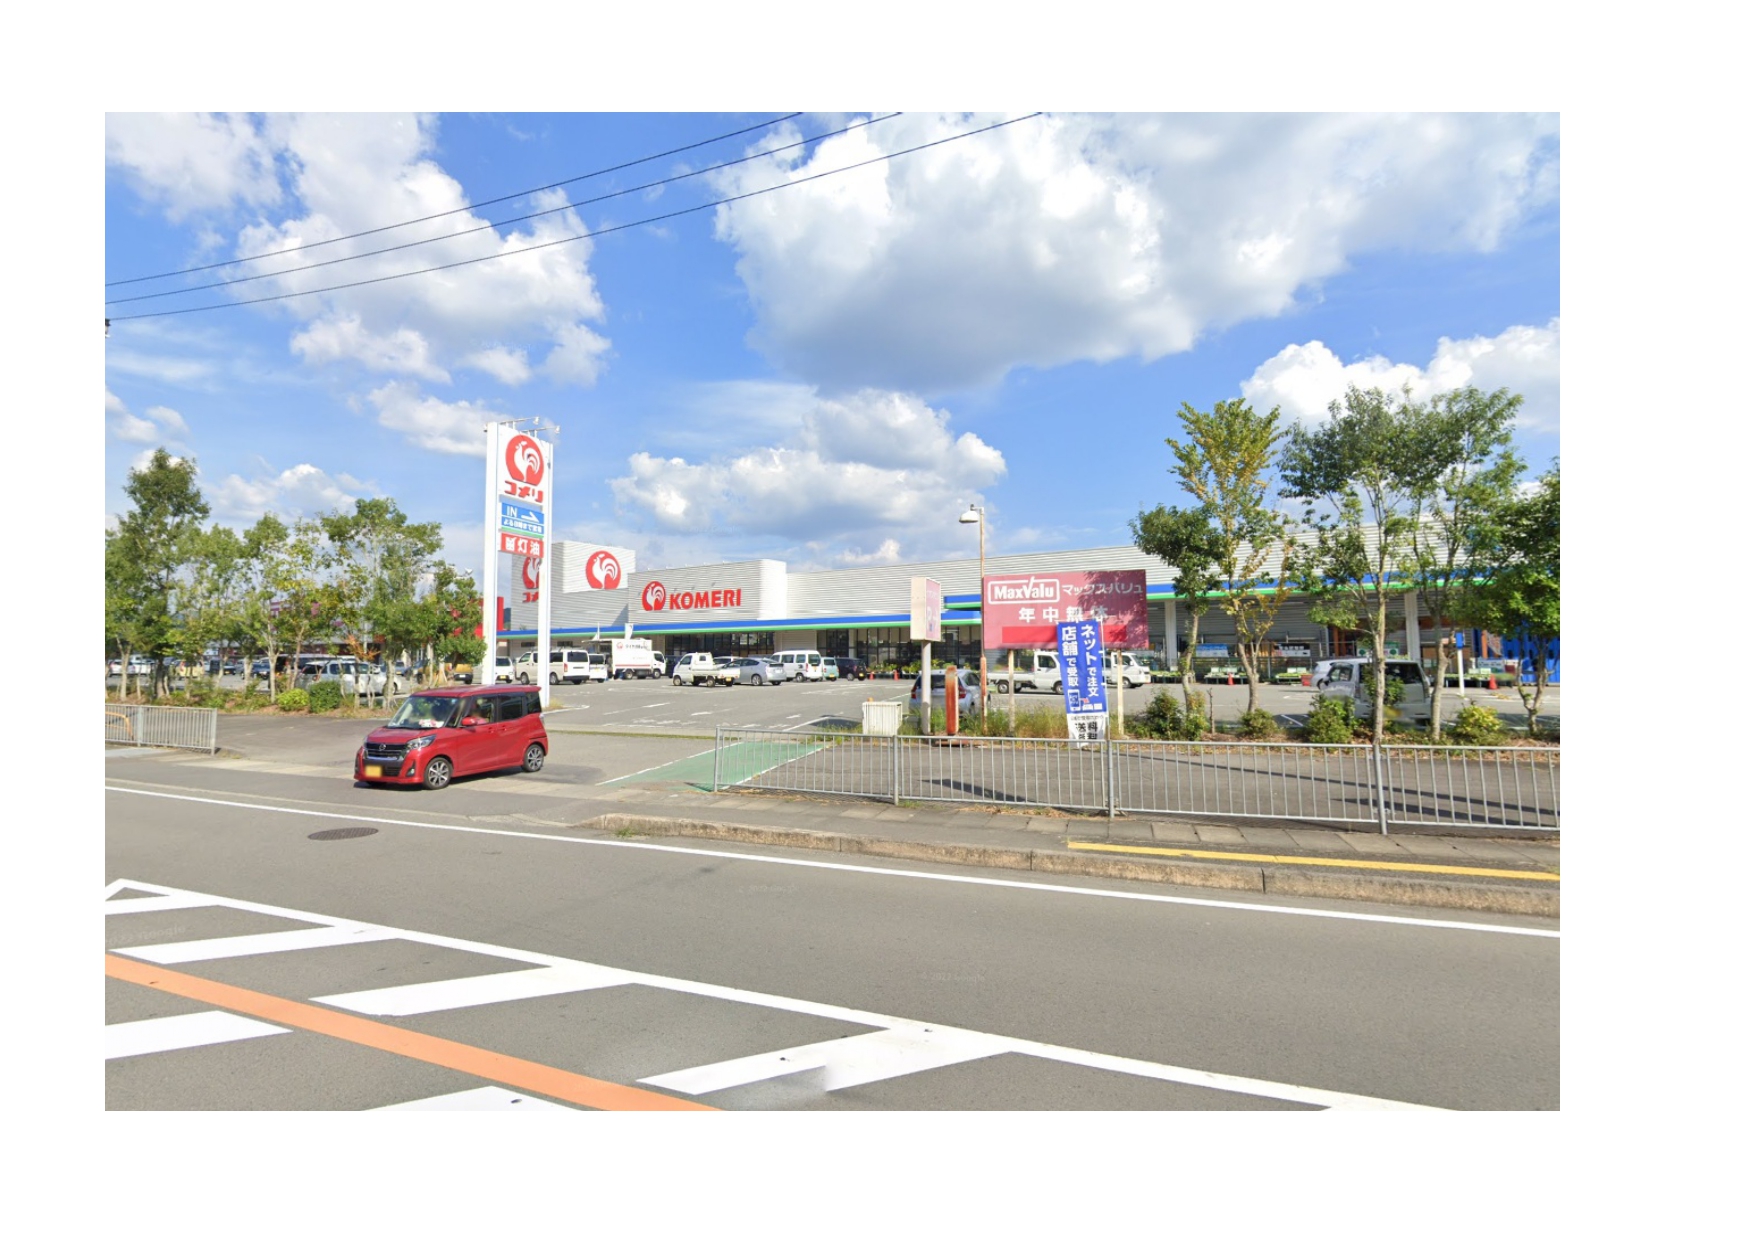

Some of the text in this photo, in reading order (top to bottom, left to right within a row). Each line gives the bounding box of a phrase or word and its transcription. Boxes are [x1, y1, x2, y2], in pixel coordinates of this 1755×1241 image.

[504, 480, 544, 503] コメリ
[506, 506, 518, 518] IN
[522, 591, 540, 603] コメ
[994, 576, 1054, 599] MaxValu
[1061, 582, 1144, 596] マックスバリュ
[669, 588, 742, 610] KOMERI
[1018, 605, 1109, 623] 年中無休
[1061, 626, 1079, 687] 店舗で受取
[1081, 624, 1099, 697] ネットで注文
